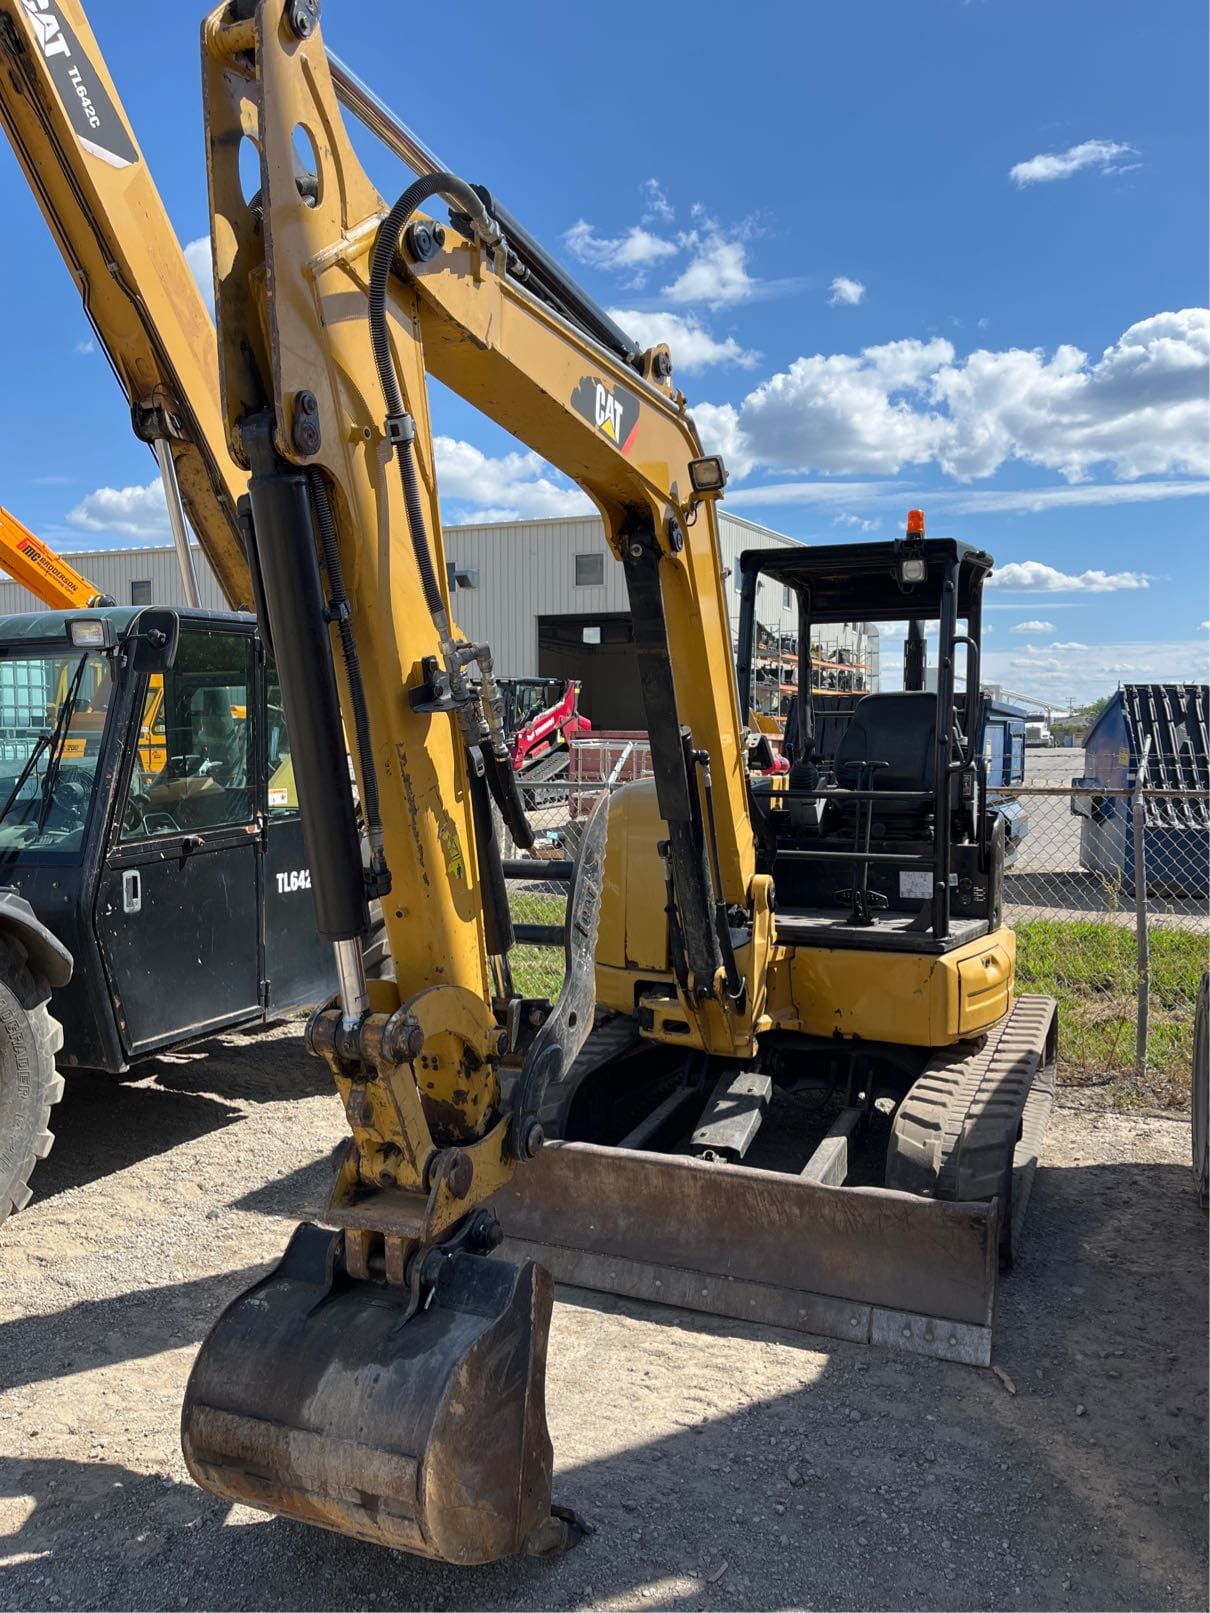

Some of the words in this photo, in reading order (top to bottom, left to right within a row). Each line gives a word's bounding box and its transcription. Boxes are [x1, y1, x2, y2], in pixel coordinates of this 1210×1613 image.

[68, 65, 100, 128] TL642C
[595, 383, 623, 444] CAT
[39, 557, 78, 592] BRODERSON
[276, 869, 312, 893] TL642
